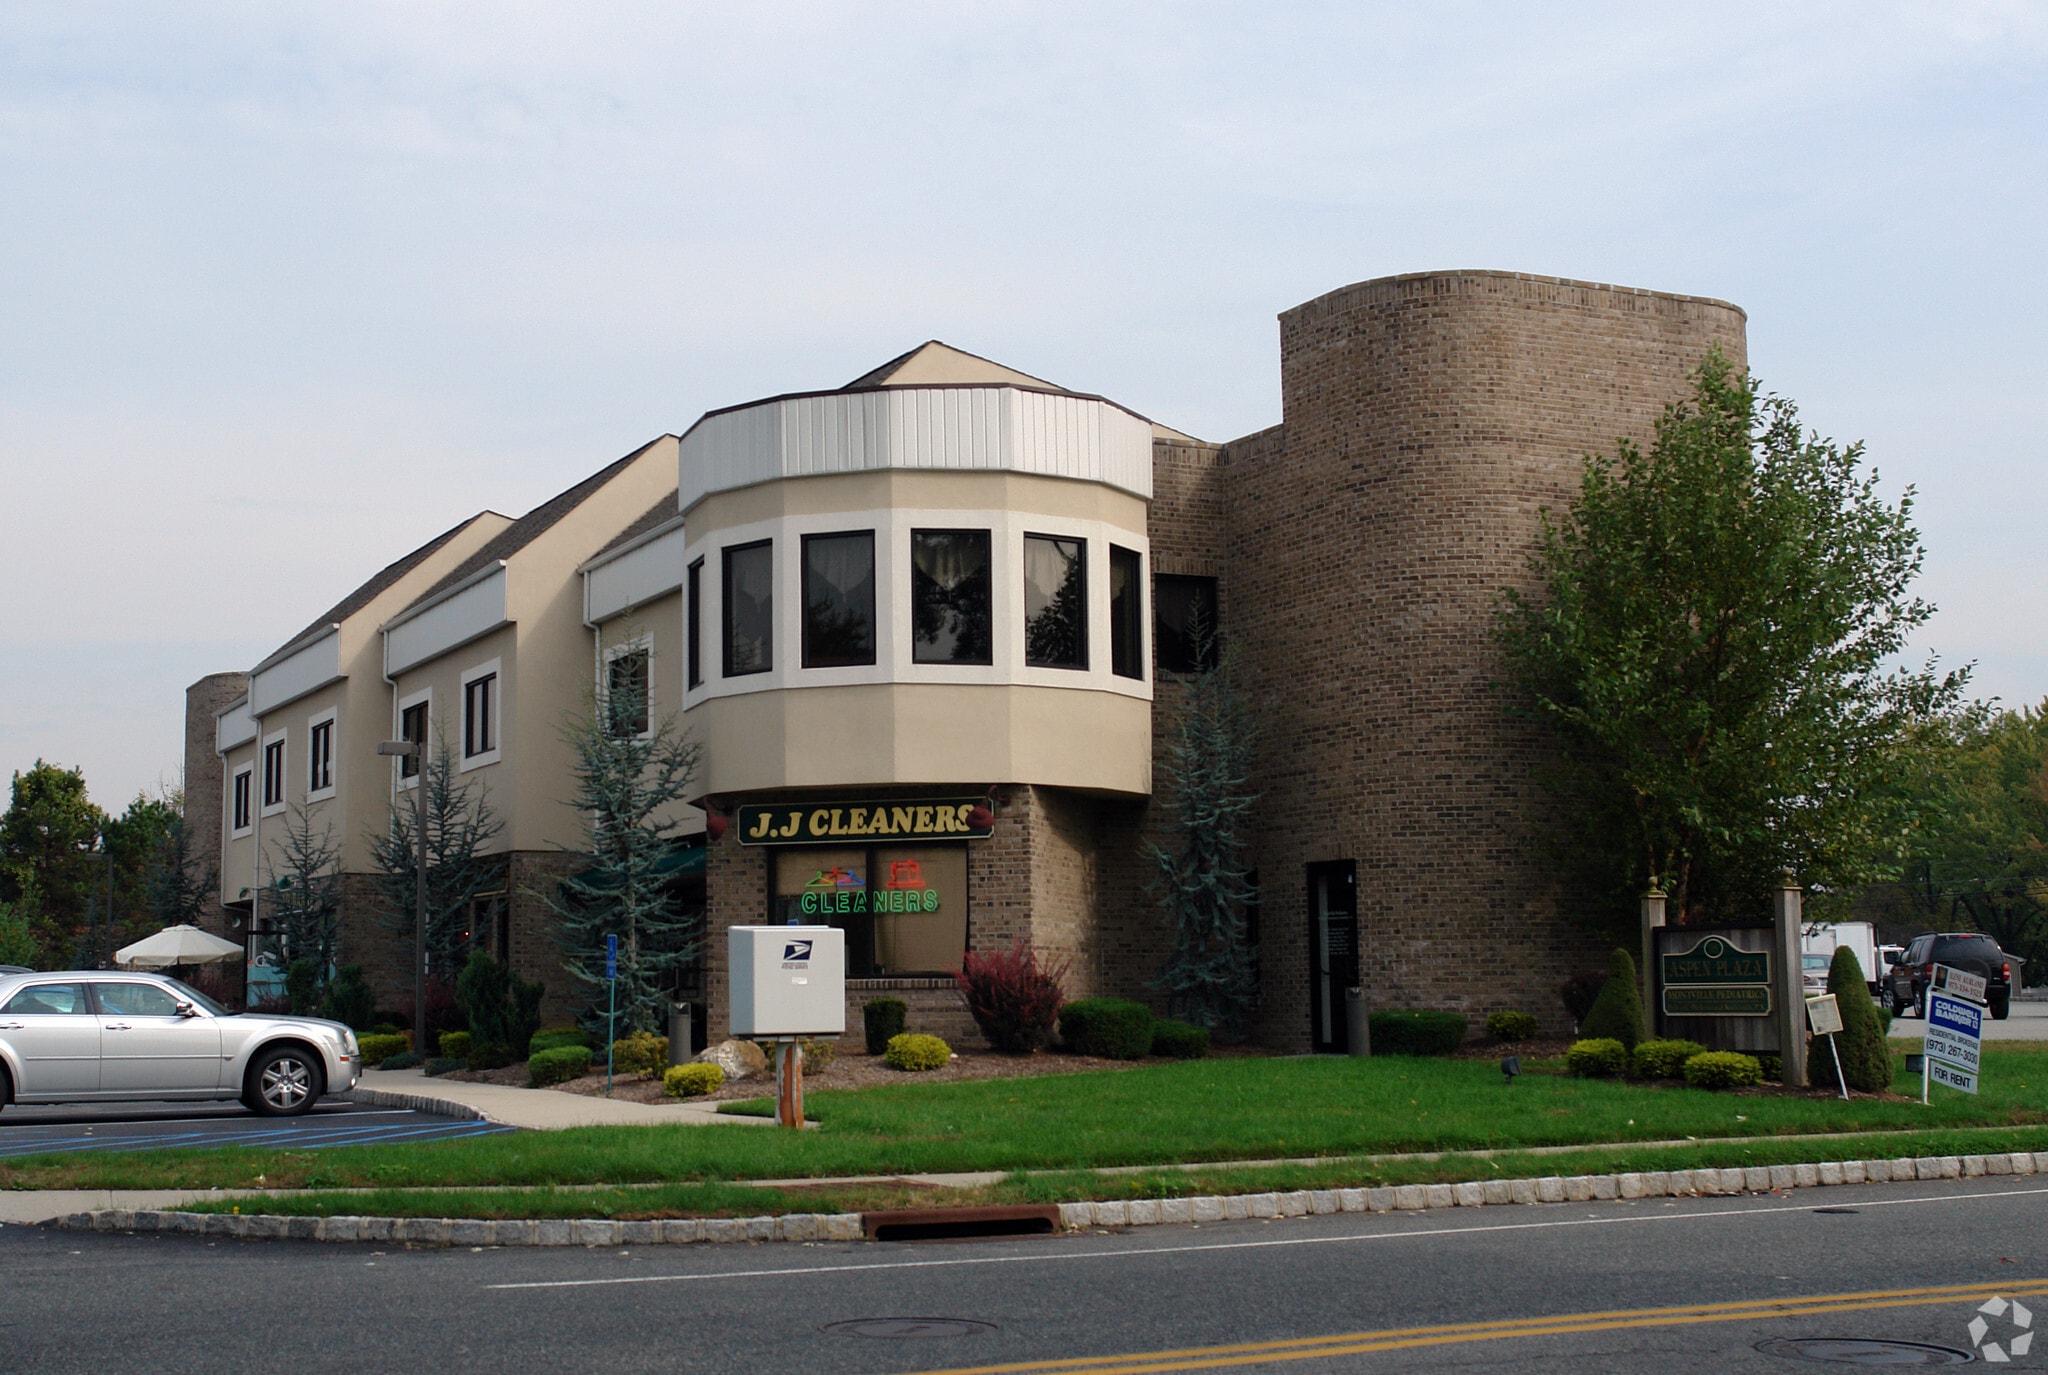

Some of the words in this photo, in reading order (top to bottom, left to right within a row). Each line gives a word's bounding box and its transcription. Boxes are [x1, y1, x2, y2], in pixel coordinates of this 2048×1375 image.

[749, 811, 802, 839] J.J
[808, 804, 975, 836] CLEANERS
[801, 889, 939, 914] CLEANERS
[1670, 960, 1711, 978] ASPEN
[1716, 959, 1763, 977] PLAZA
[1668, 989, 1714, 1000] MONTVILLE
[1716, 989, 1765, 1000] PEDIATRICS
[1935, 1001, 1979, 1020] COLDWELL
[1935, 1009, 1972, 1026] BANKER
[1926, 1039, 1946, 1054] (973)
[1934, 1066, 1948, 1081] FOR
[1950, 1072, 1971, 1088] RENT
